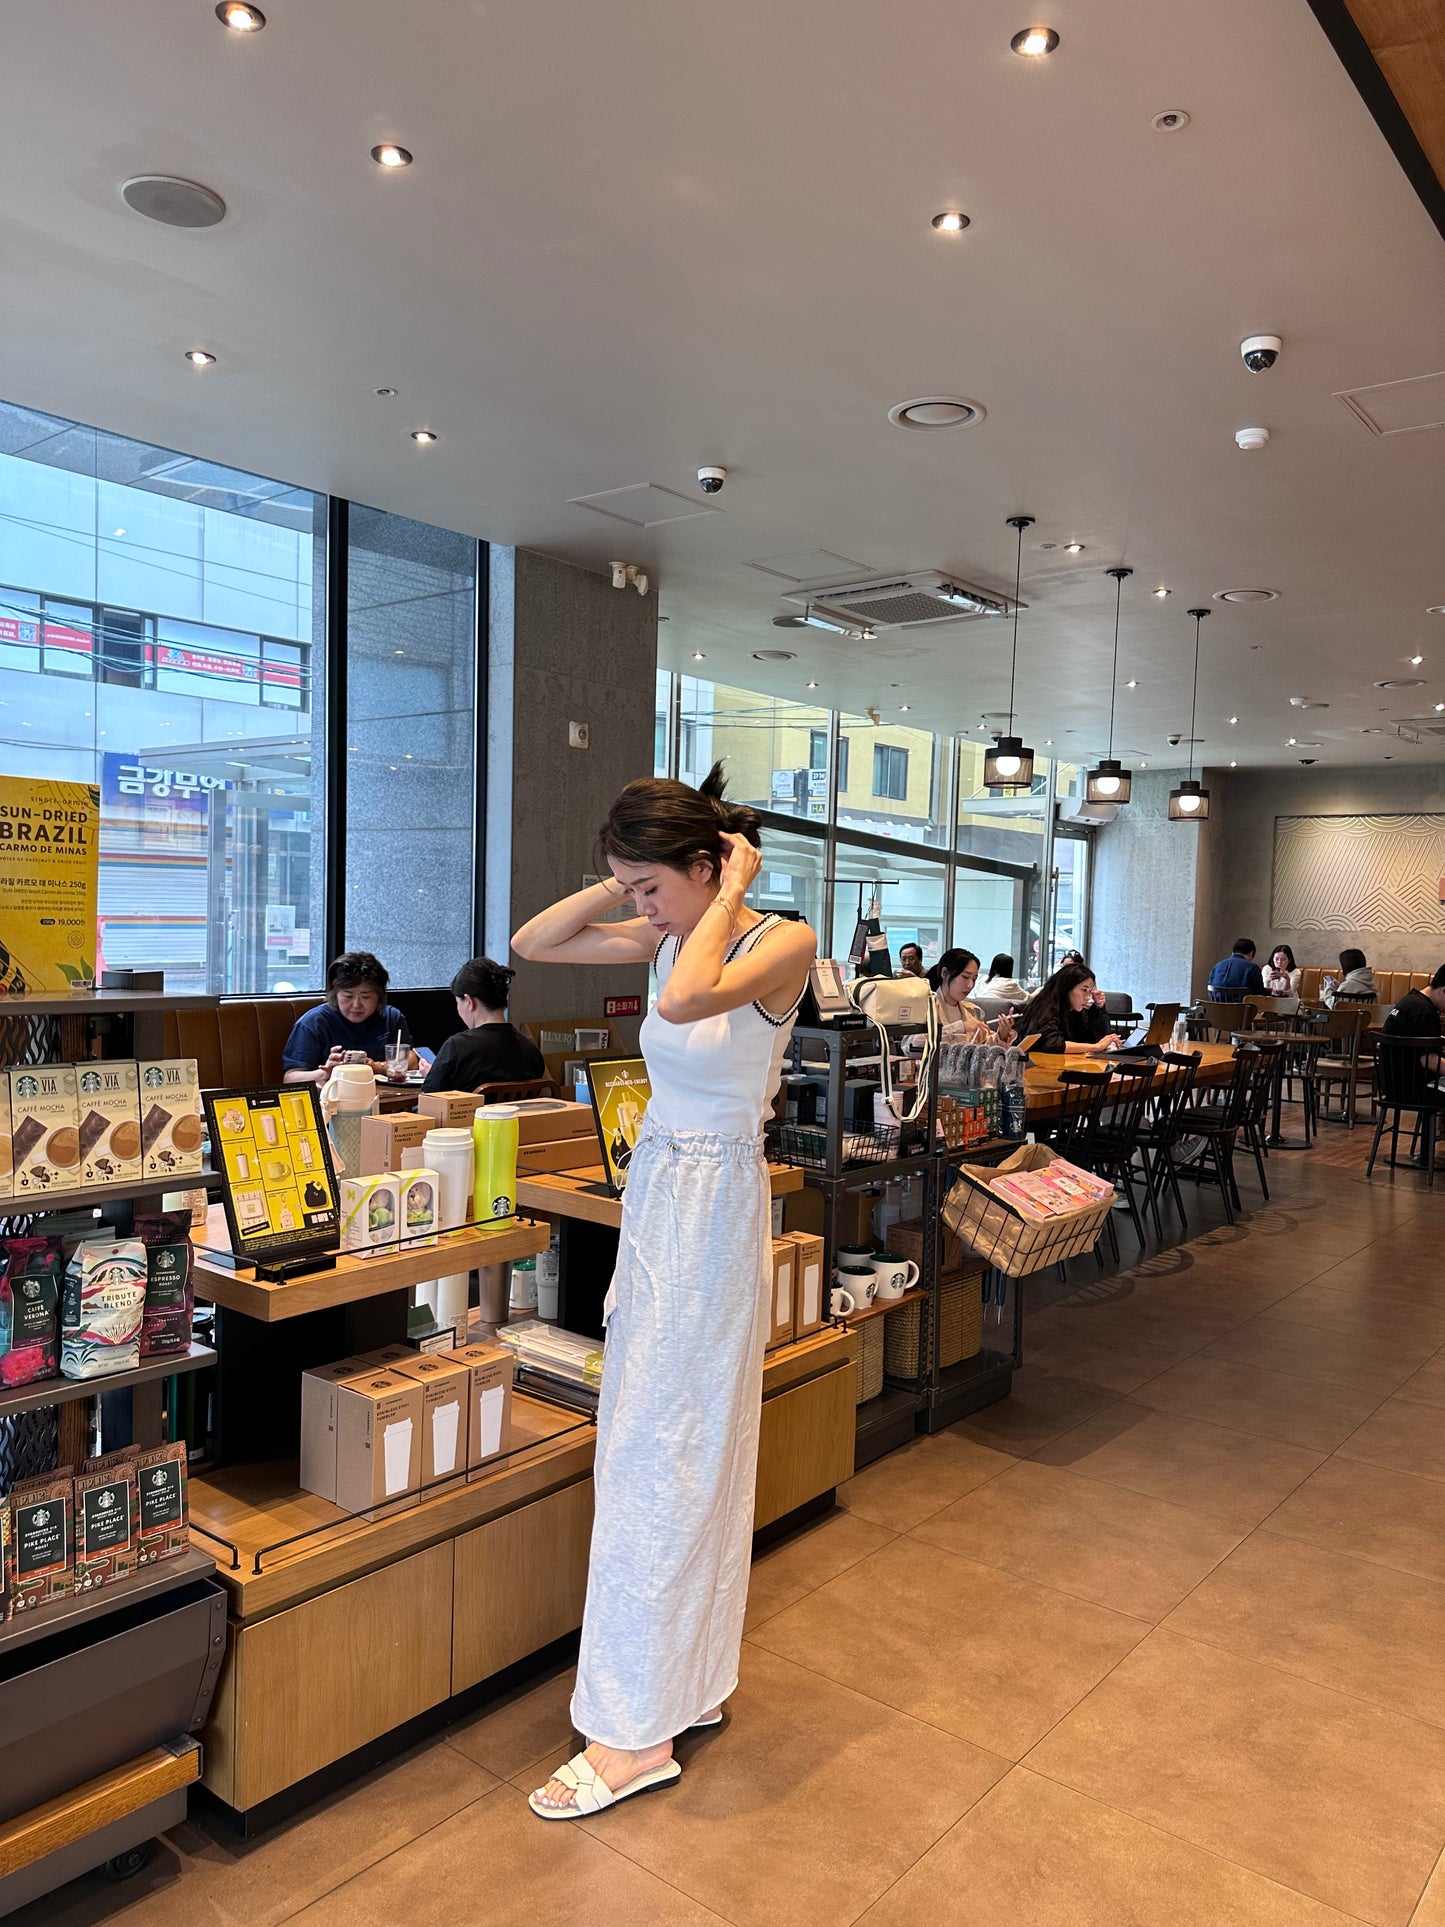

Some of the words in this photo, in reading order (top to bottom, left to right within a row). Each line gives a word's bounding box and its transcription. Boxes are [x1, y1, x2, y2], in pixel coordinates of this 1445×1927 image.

[0, 806, 87, 823] SUN-DRIED
[0, 822, 87, 844] BRAZIL
[0, 843, 37, 853] CARMO
[40, 846, 52, 854] DE
[55, 846, 87, 855] MINAS
[48, 879, 68, 888] 미나스
[69, 880, 87, 889] 250g
[105, 1075, 119, 1087] VIA
[166, 1070, 181, 1082] VIA
[41, 1080, 57, 1092] VIA
[40, 1103, 65, 1111] MOCHA
[101, 1291, 137, 1302] TRIBUTE
[104, 1300, 132, 1309] BLEND
[24, 1310, 50, 1320] VERONA
[145, 1498, 158, 1507] PIKE
[90, 1520, 104, 1530] PIKE
[23, 1540, 39, 1549] PIKE
